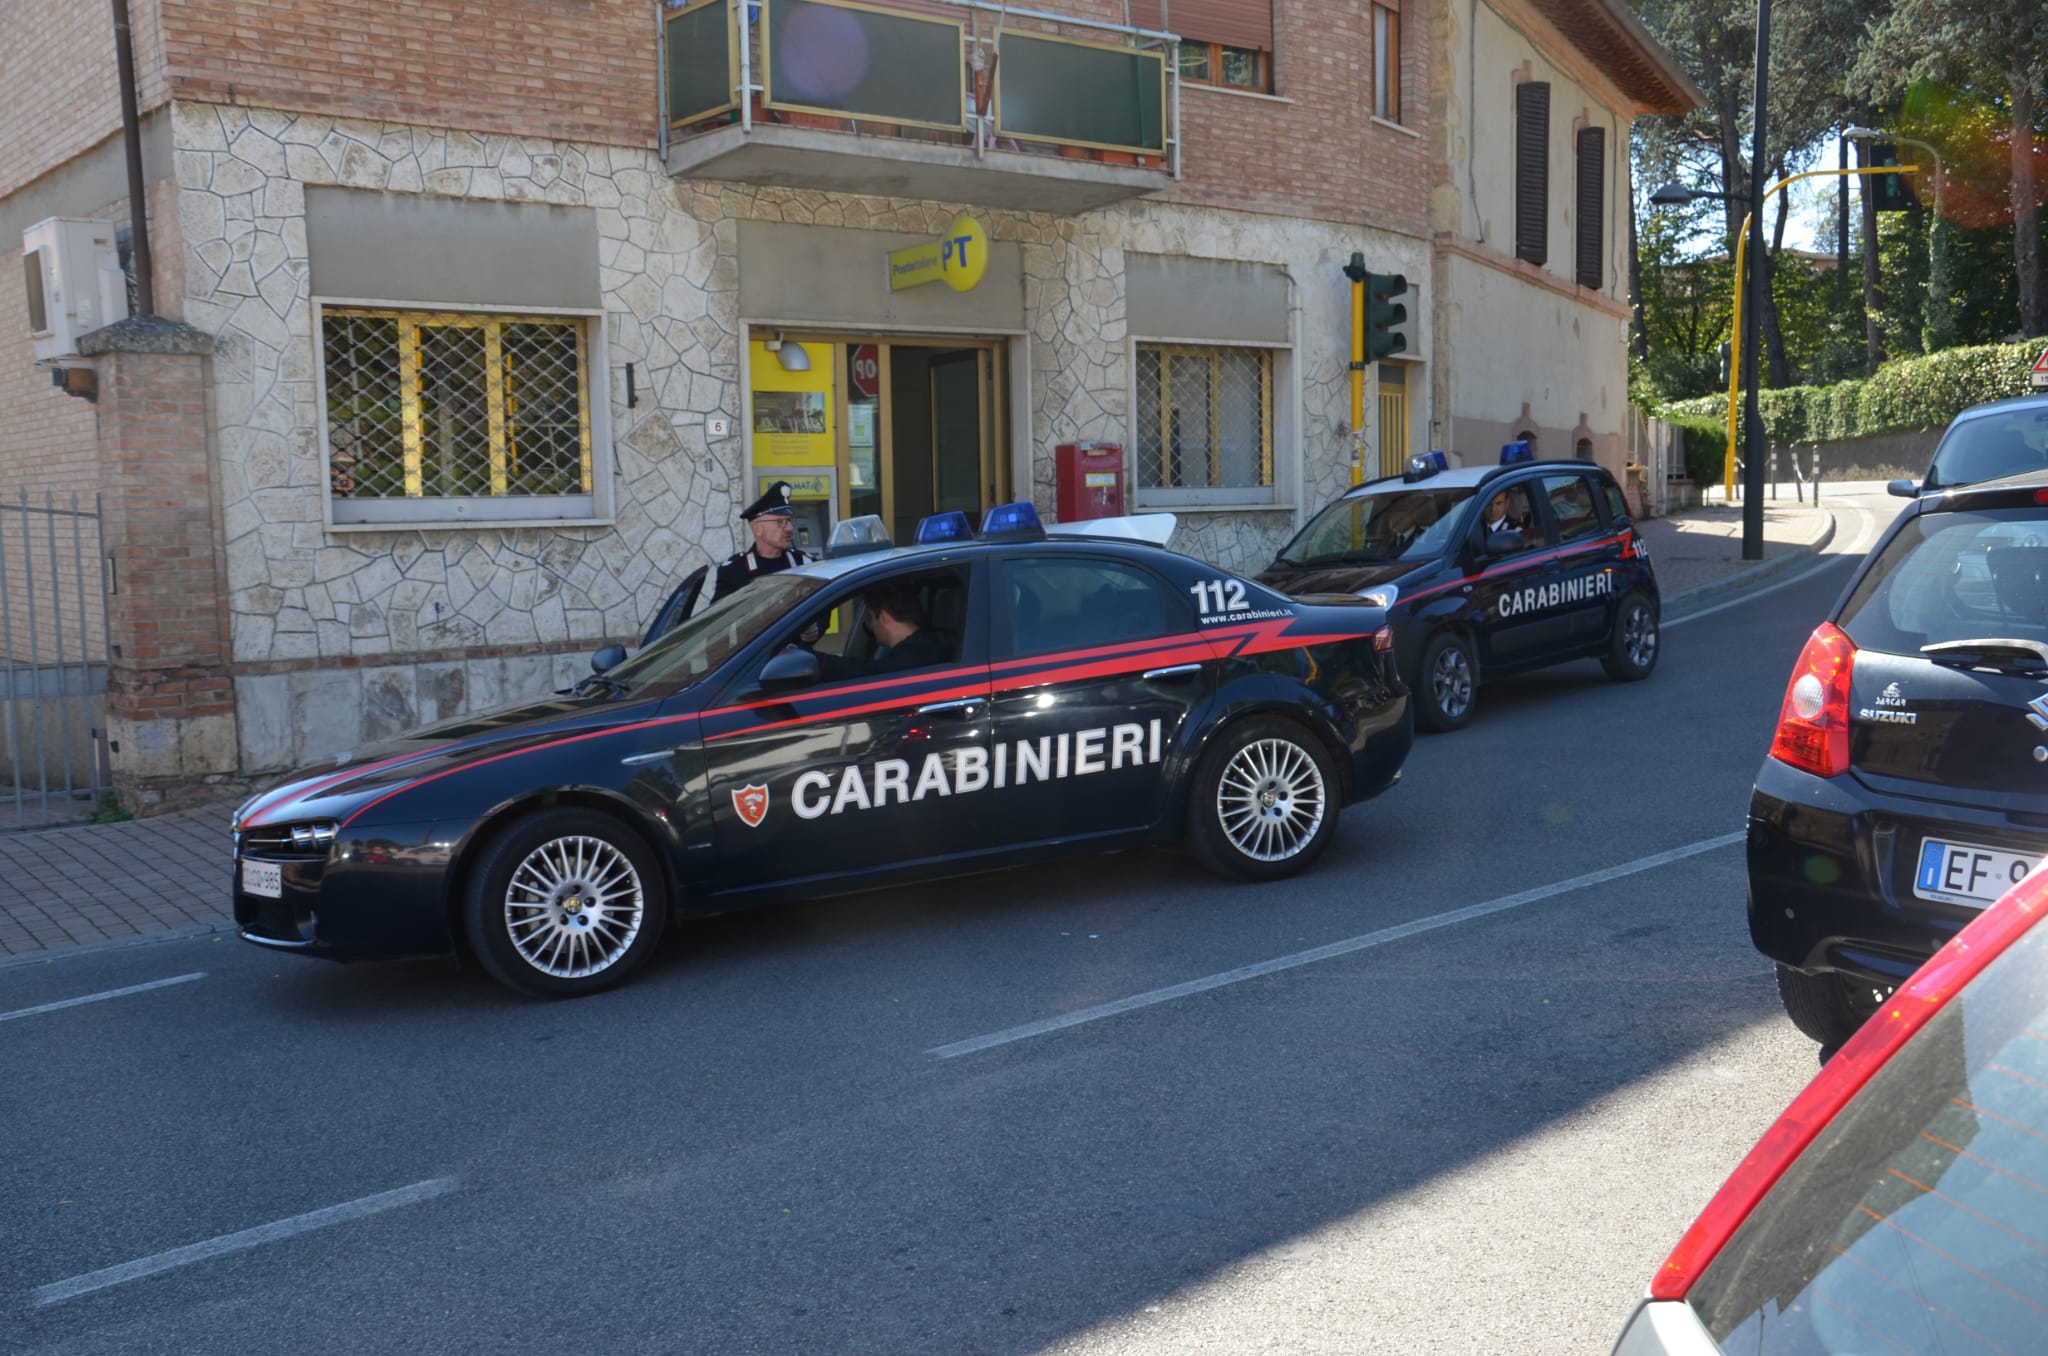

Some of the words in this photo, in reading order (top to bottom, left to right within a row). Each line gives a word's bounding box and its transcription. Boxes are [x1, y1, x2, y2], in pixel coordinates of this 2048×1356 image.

[942, 235, 973, 272] PT
[714, 421, 722, 433] 6
[1632, 539, 1649, 559] 112
[1190, 579, 1250, 614] 112
[1499, 572, 1612, 618] CARABINIERI
[1200, 608, 1295, 625] www.carabinieri.it
[1859, 708, 1917, 724] SUZUKI
[791, 718, 1161, 820] CARABINIERI
